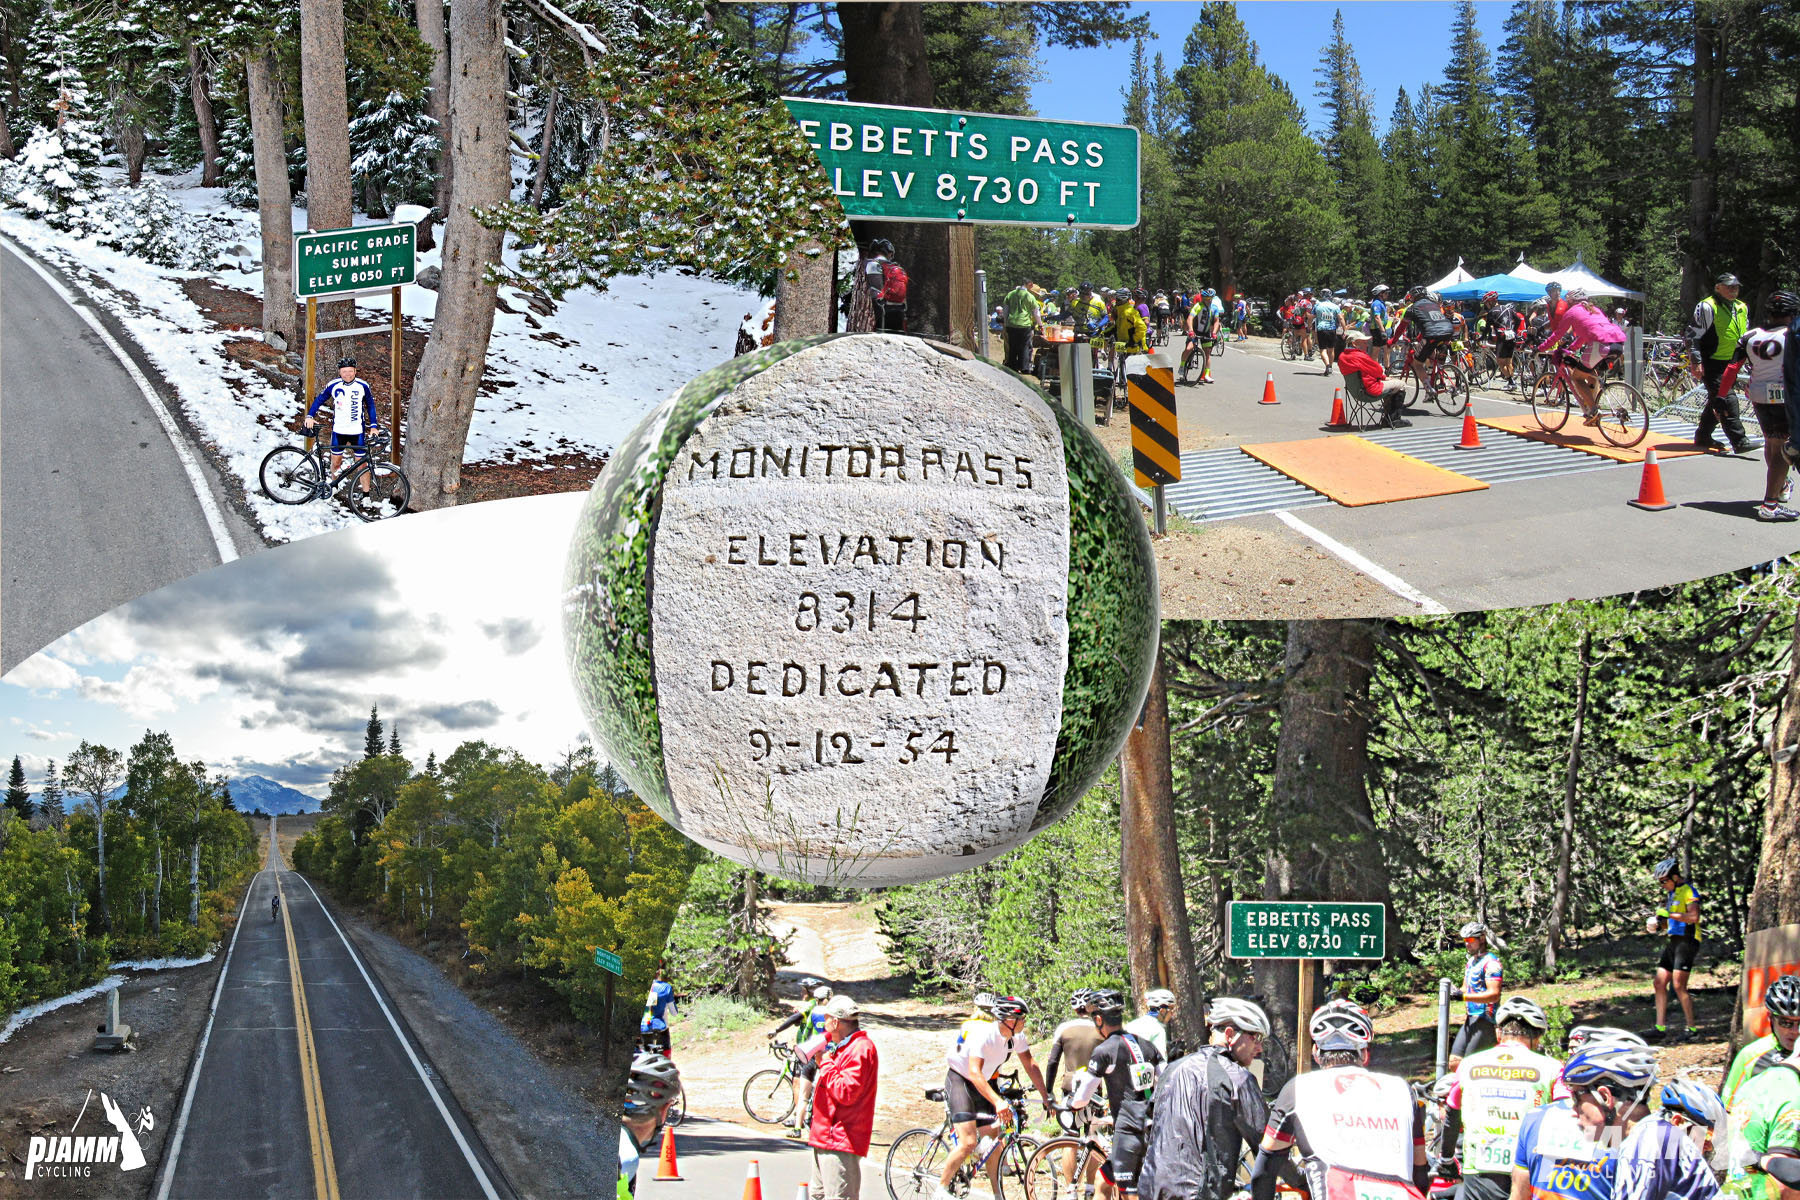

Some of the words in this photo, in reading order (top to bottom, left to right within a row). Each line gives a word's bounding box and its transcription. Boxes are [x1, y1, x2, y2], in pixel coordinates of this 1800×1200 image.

[800, 120, 988, 161] EBBETTS
[1011, 136, 1104, 168] PASS
[936, 172, 1039, 205] 8,730
[1060, 180, 1101, 207] FT
[305, 240, 358, 256] PACIFIC
[367, 233, 409, 249] GRADE
[332, 253, 383, 269] SUMMIT
[309, 274, 342, 288] ELEV
[351, 269, 383, 283] 8050
[391, 266, 405, 278] FT
[351, 390, 359, 422] PJAMM
[687, 444, 907, 481] MONITOR
[921, 447, 1033, 490] PASS
[728, 534, 1004, 571] ELEVATION
[795, 590, 927, 633] 8314
[710, 659, 1008, 698] DEDICATED
[748, 728, 960, 765] 9-12-54
[1247, 911, 1320, 927] EBBETTS
[1331, 912, 1371, 927] PASS
[1248, 934, 1290, 949] ELEV
[1298, 934, 1341, 950] 8,730
[1360, 935, 1376, 949] FT
[1137, 1071, 1152, 1086] 182
[1471, 1065, 1537, 1080] navigare
[1333, 1113, 1400, 1131] PJAMM
[1484, 1146, 1512, 1165] 358
[1547, 1169, 1591, 1192] 100
